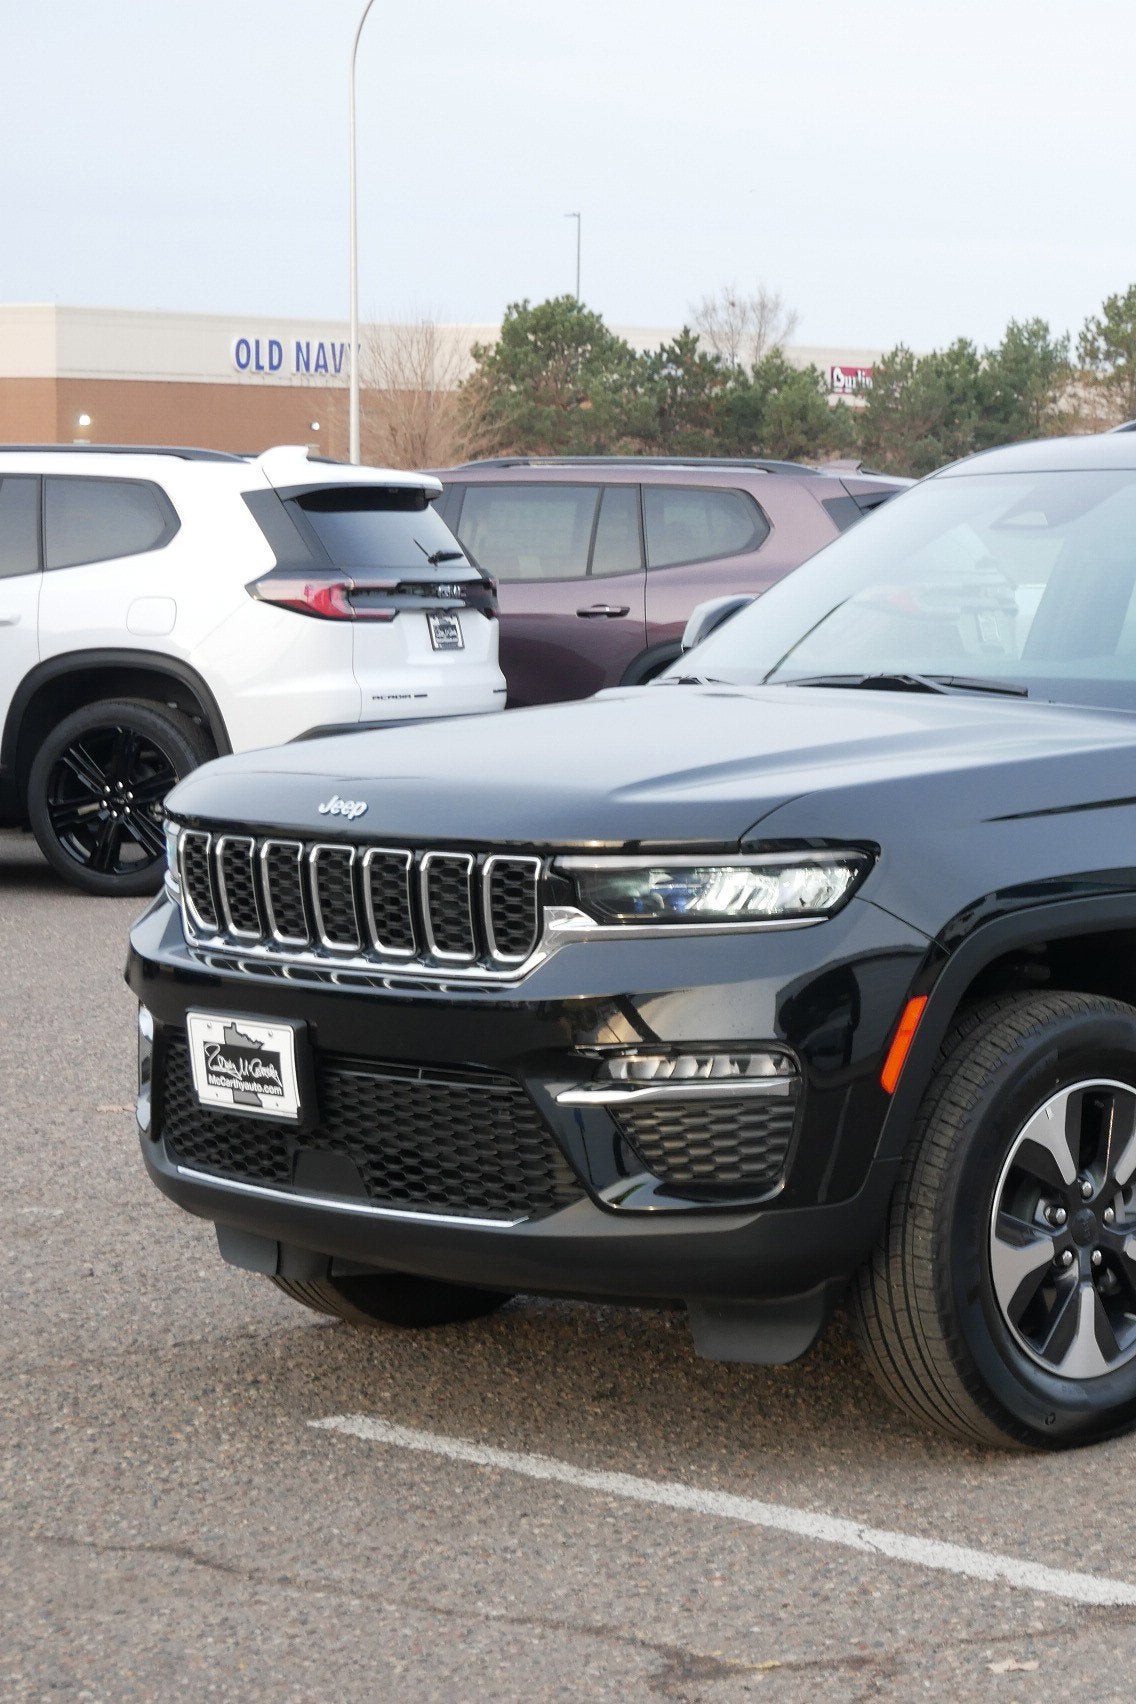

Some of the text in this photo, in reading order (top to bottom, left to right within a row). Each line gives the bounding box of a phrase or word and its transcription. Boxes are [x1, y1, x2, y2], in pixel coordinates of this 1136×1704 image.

[235, 338, 361, 374] OLD NAV
[318, 794, 368, 821] Jeep
[207, 1073, 284, 1096] McCarthyauto.com
